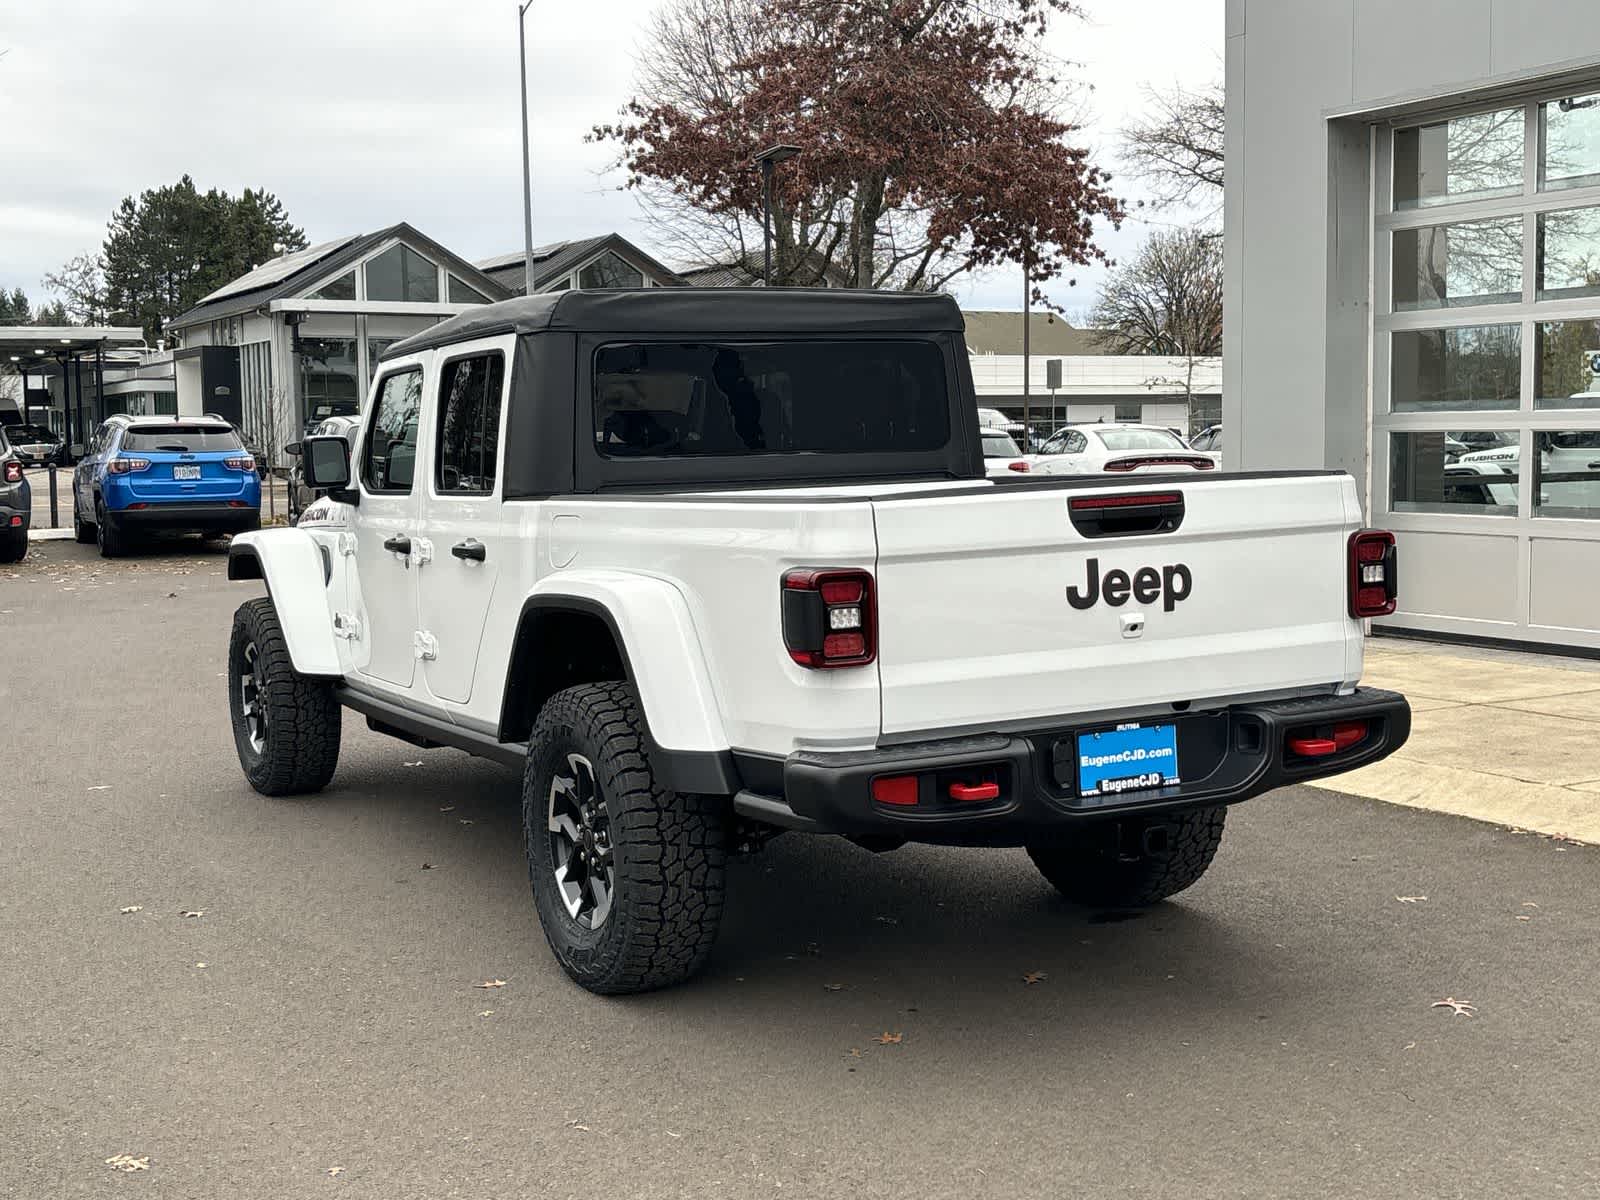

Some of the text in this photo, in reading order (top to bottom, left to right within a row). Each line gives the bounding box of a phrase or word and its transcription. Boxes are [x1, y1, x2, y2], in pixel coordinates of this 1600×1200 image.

[1464, 453, 1514, 462] RUBICON
[1066, 558, 1192, 612] Jeep
[1081, 747, 1173, 767] EugeneCJD.com
[1102, 773, 1160, 792] EugeneCJD
